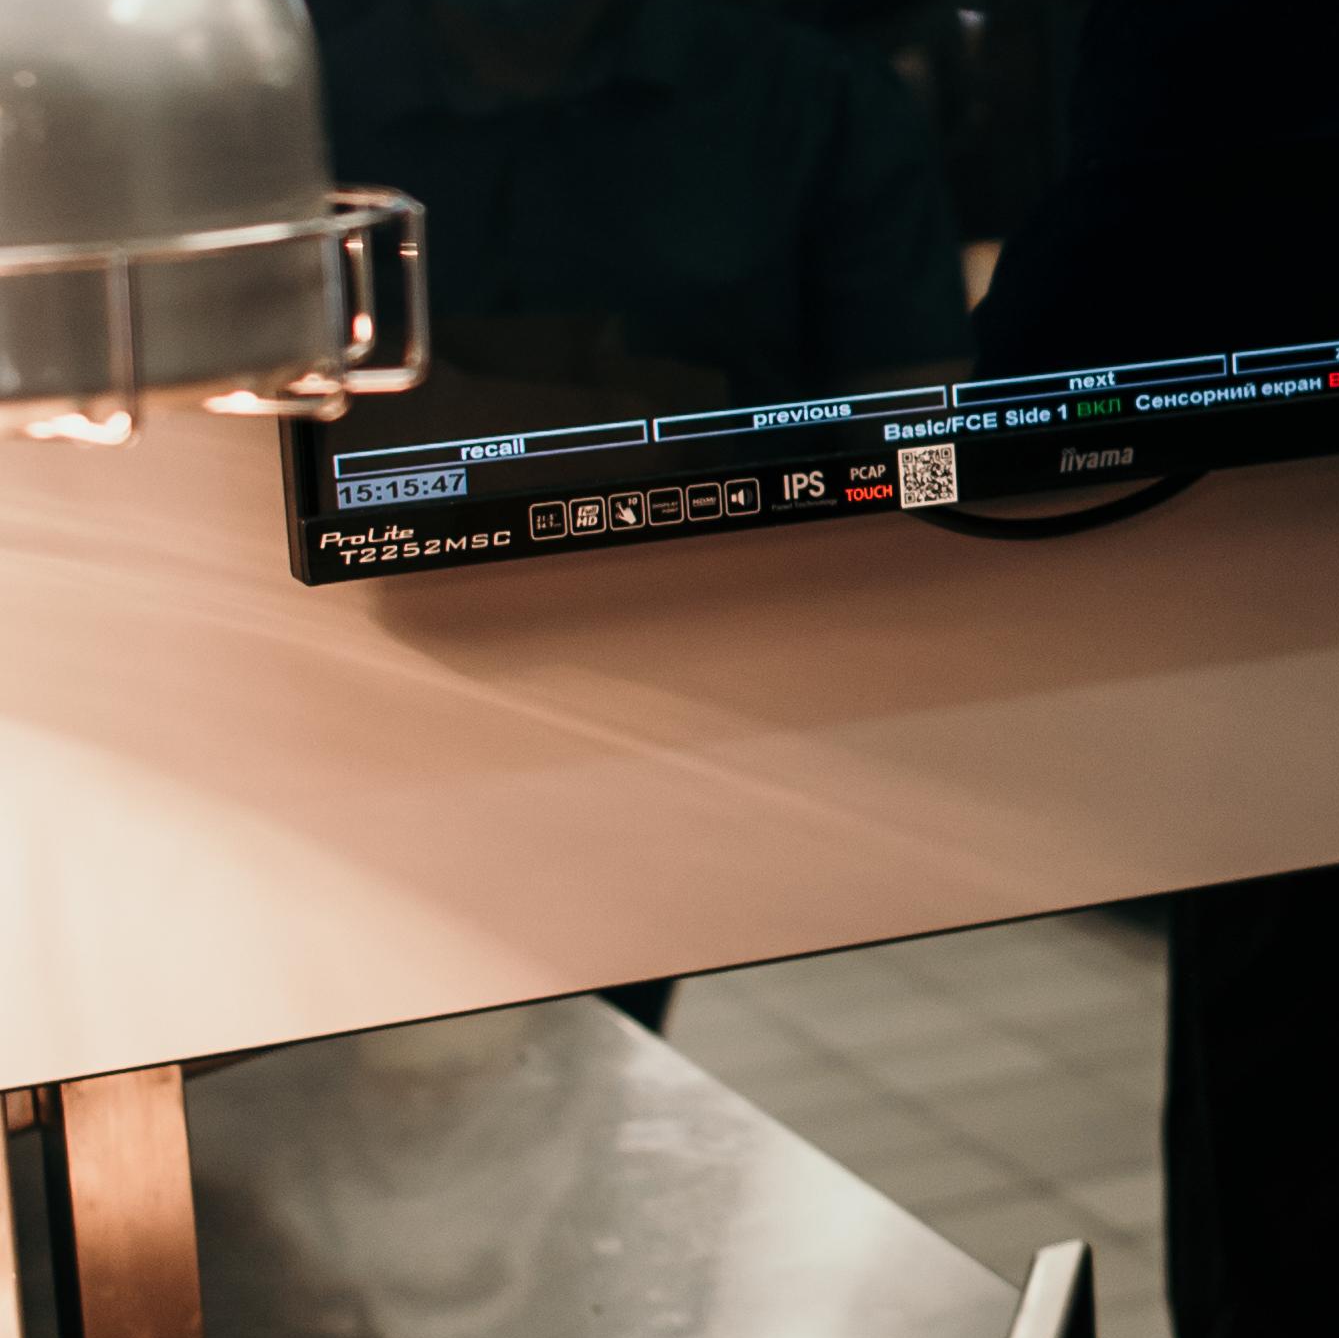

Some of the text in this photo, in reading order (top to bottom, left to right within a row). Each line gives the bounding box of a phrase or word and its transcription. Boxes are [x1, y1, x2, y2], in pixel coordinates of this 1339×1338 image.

[1068, 370, 1116, 391] next
[752, 401, 852, 429] previous
[883, 412, 998, 441] Basic/FCE
[1005, 407, 1051, 428] Side
[1057, 405, 1068, 421] 1
[1076, 398, 1121, 419] ВКЛ
[1135, 380, 1257, 412] Сенсорний
[1261, 375, 1322, 398] екран
[460, 438, 526, 461] recall
[850, 464, 886, 481] PCAP
[337, 472, 466, 505] 15:15:47
[783, 470, 825, 500] IPS
[845, 484, 893, 502] TOUCH
[576, 516, 598, 528] HD
[579, 504, 599, 517] Full
[320, 525, 415, 550] ProLite
[339, 530, 512, 566] T2252MSC
